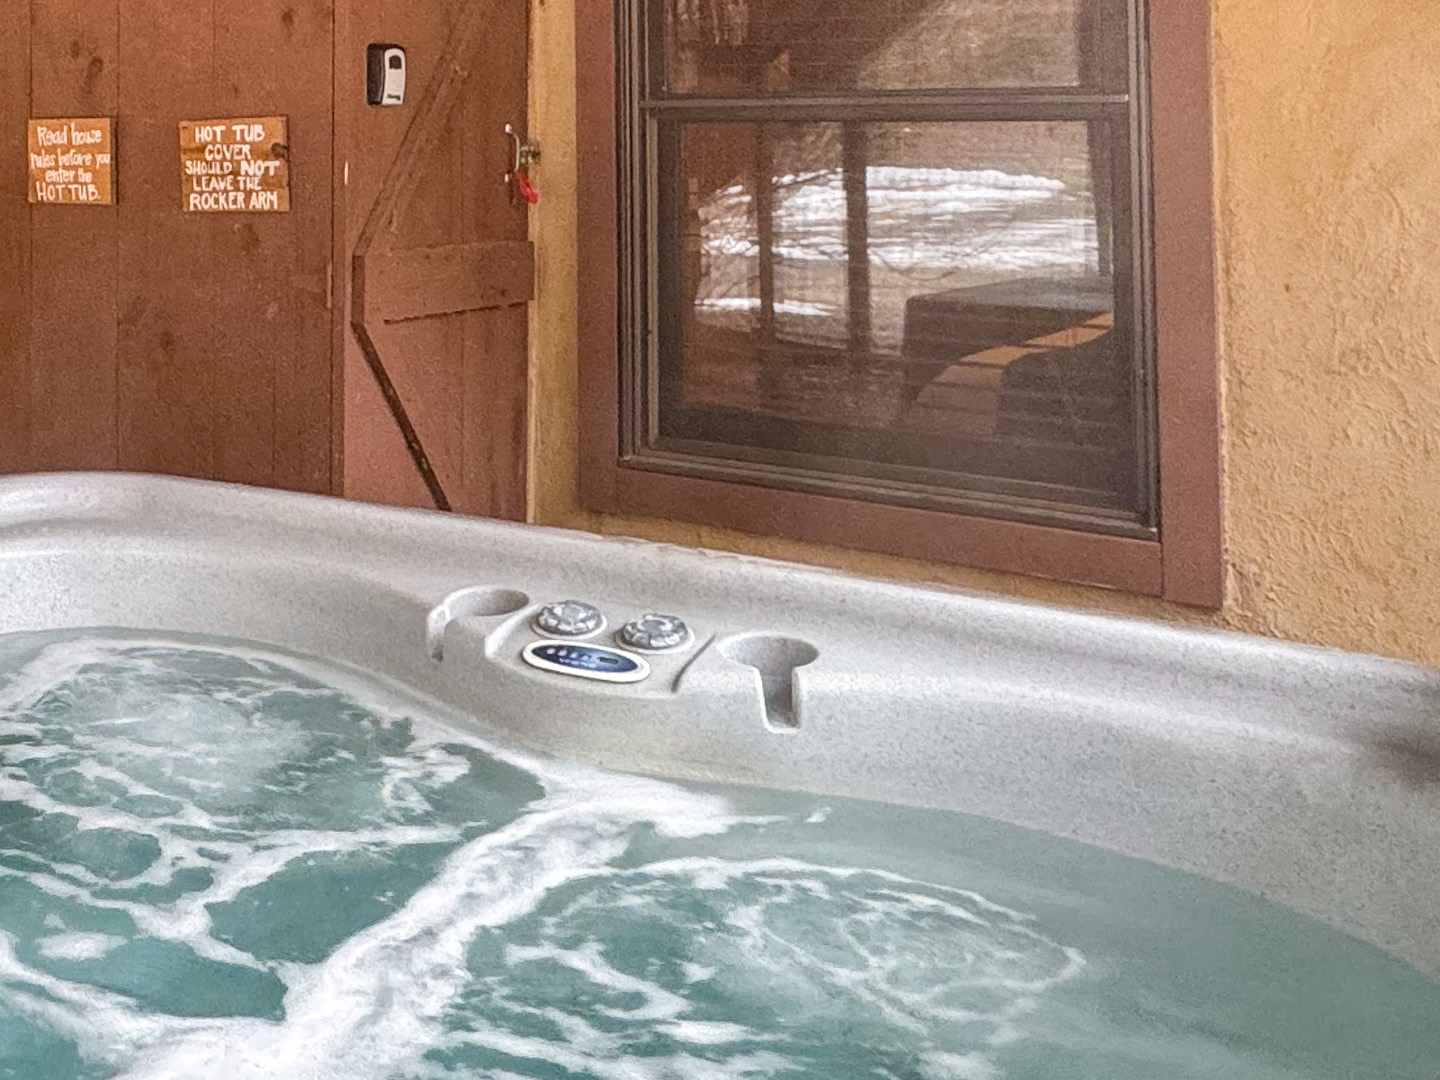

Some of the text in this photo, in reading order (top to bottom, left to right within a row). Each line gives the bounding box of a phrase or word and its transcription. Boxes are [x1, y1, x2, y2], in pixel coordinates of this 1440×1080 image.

[36, 121, 102, 146] Read house
[195, 124, 265, 143] HOT TUB
[30, 148, 111, 169] rules before you
[205, 144, 252, 161] COVER
[45, 167, 92, 183] enter the
[185, 160, 280, 176] SHOULD NOT
[35, 181, 66, 201] HOT
[193, 175, 262, 191] LEAVE THE
[189, 190, 278, 211] ROCKER ARM
